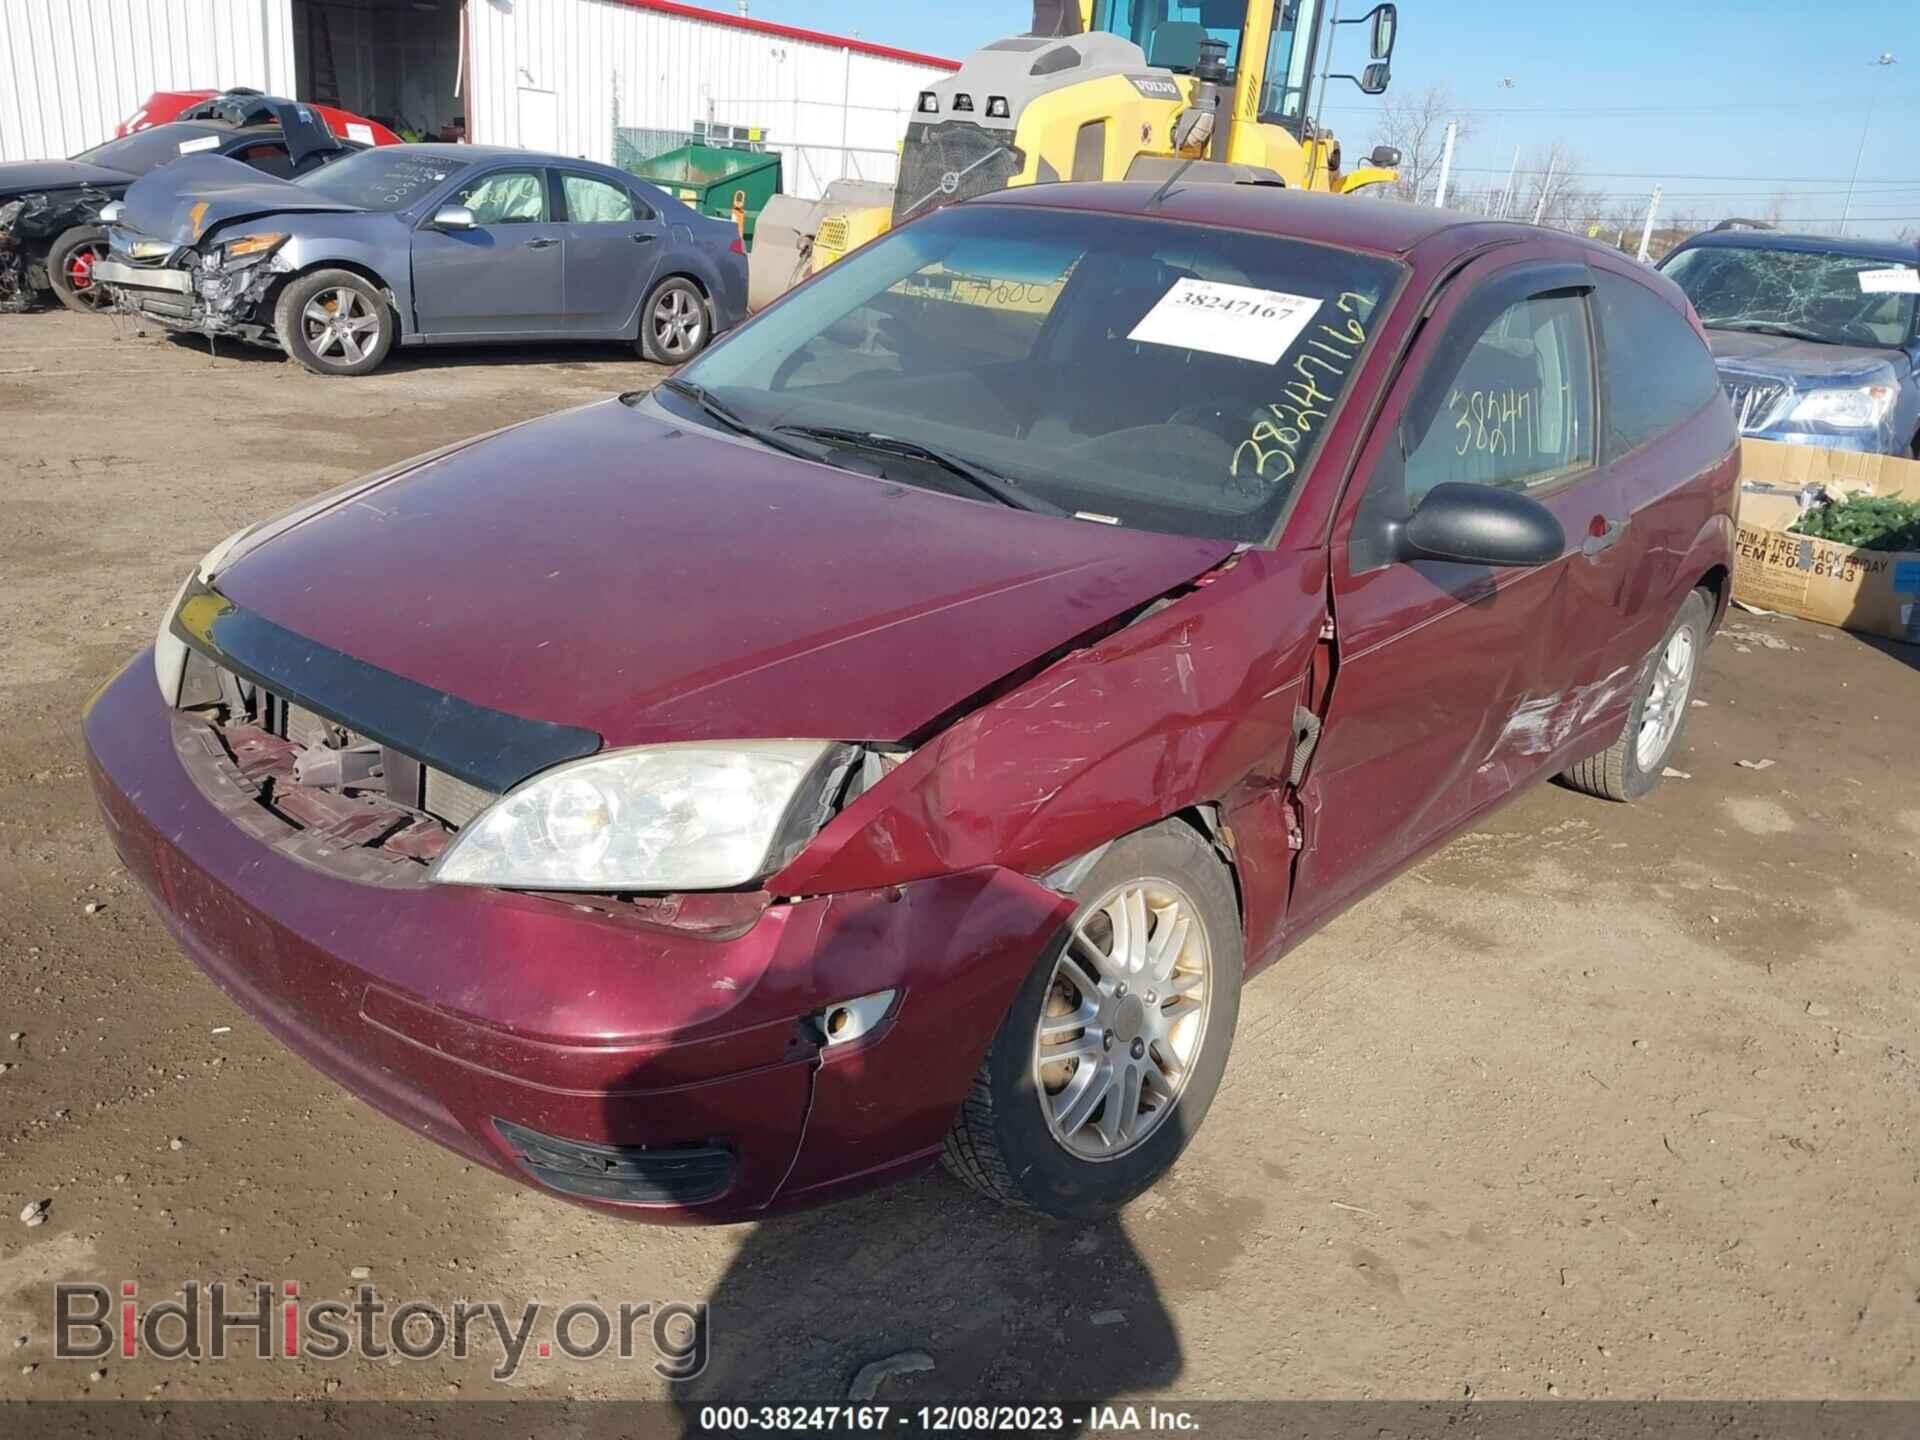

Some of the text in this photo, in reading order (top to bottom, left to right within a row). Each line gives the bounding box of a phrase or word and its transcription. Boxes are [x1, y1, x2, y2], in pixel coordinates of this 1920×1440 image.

[1134, 79, 1177, 94] VOLVO
[1176, 291, 1294, 320] 38247167
[1230, 292, 1376, 482] 38247167
[1735, 527, 1801, 556] RIM-A-TREE
[1844, 554, 1888, 575] FRIDAY
